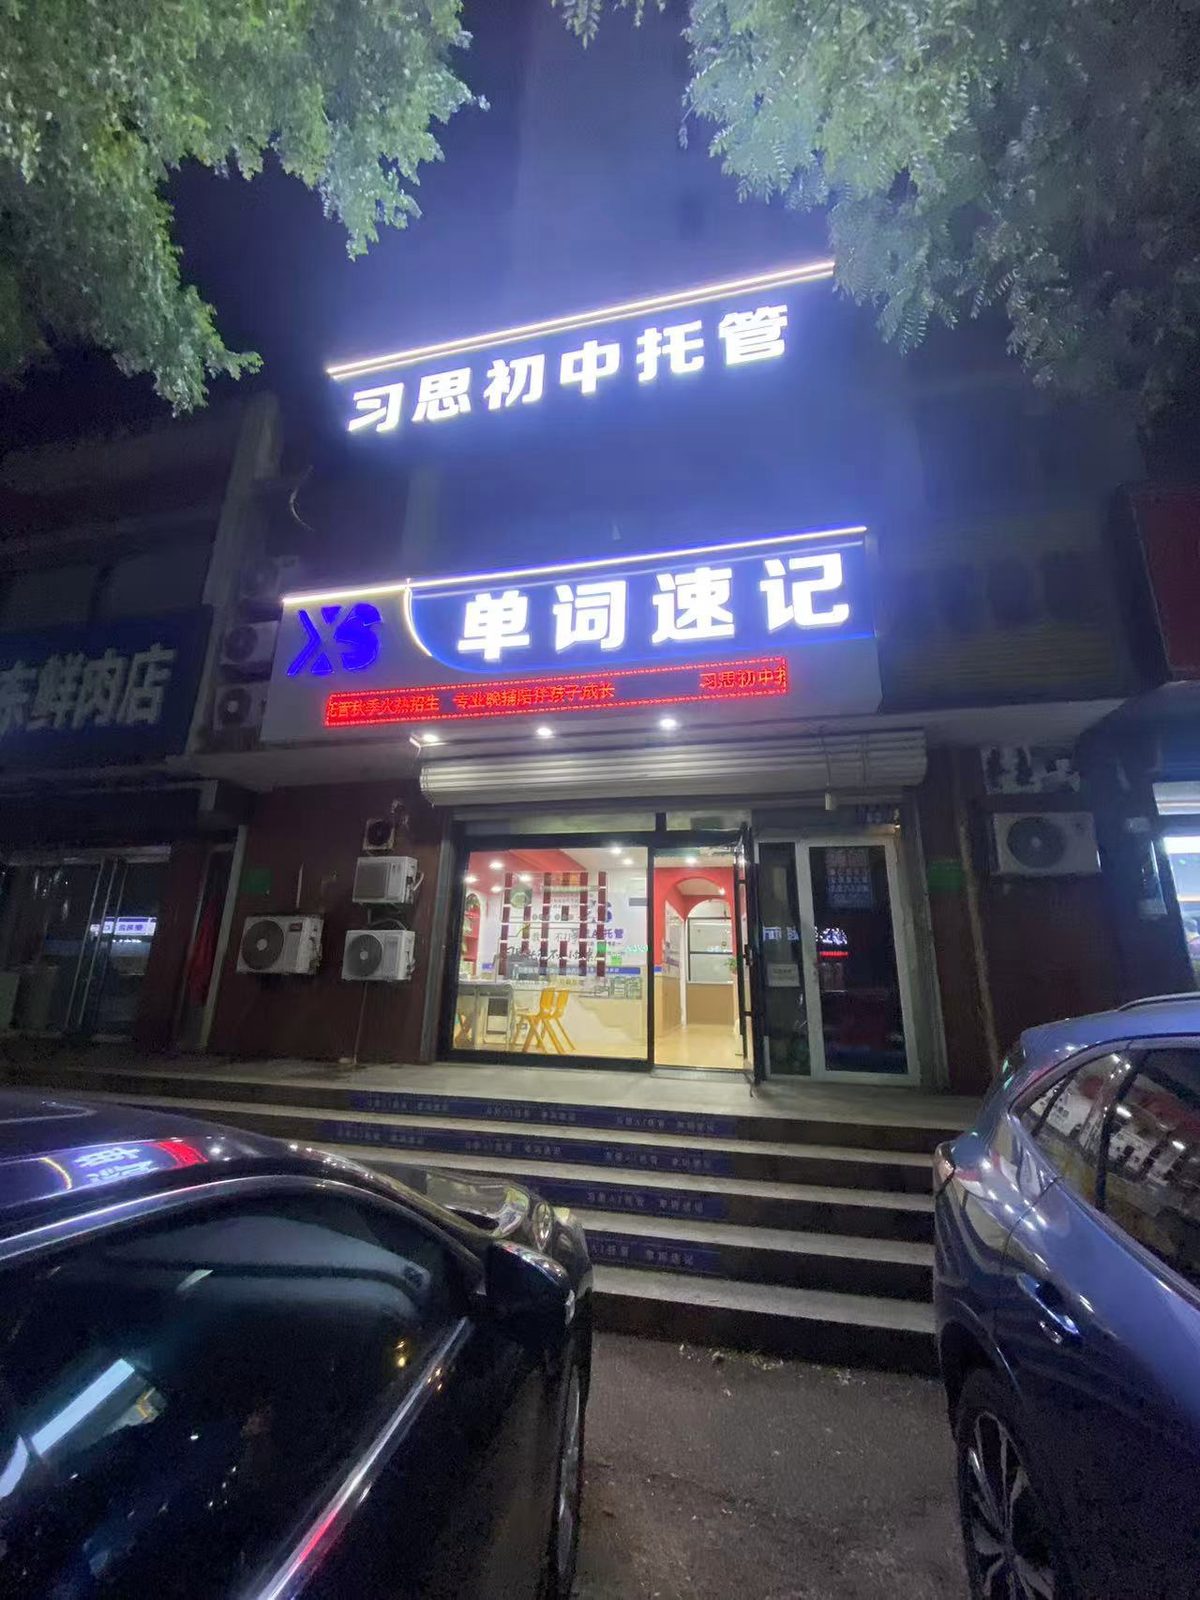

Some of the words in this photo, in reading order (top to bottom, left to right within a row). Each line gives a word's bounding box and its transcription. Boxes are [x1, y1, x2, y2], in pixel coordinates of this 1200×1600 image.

[346, 303, 789, 434] 习思初中托管
[286, 602, 384, 677] XS
[456, 551, 851, 663] 单词速记
